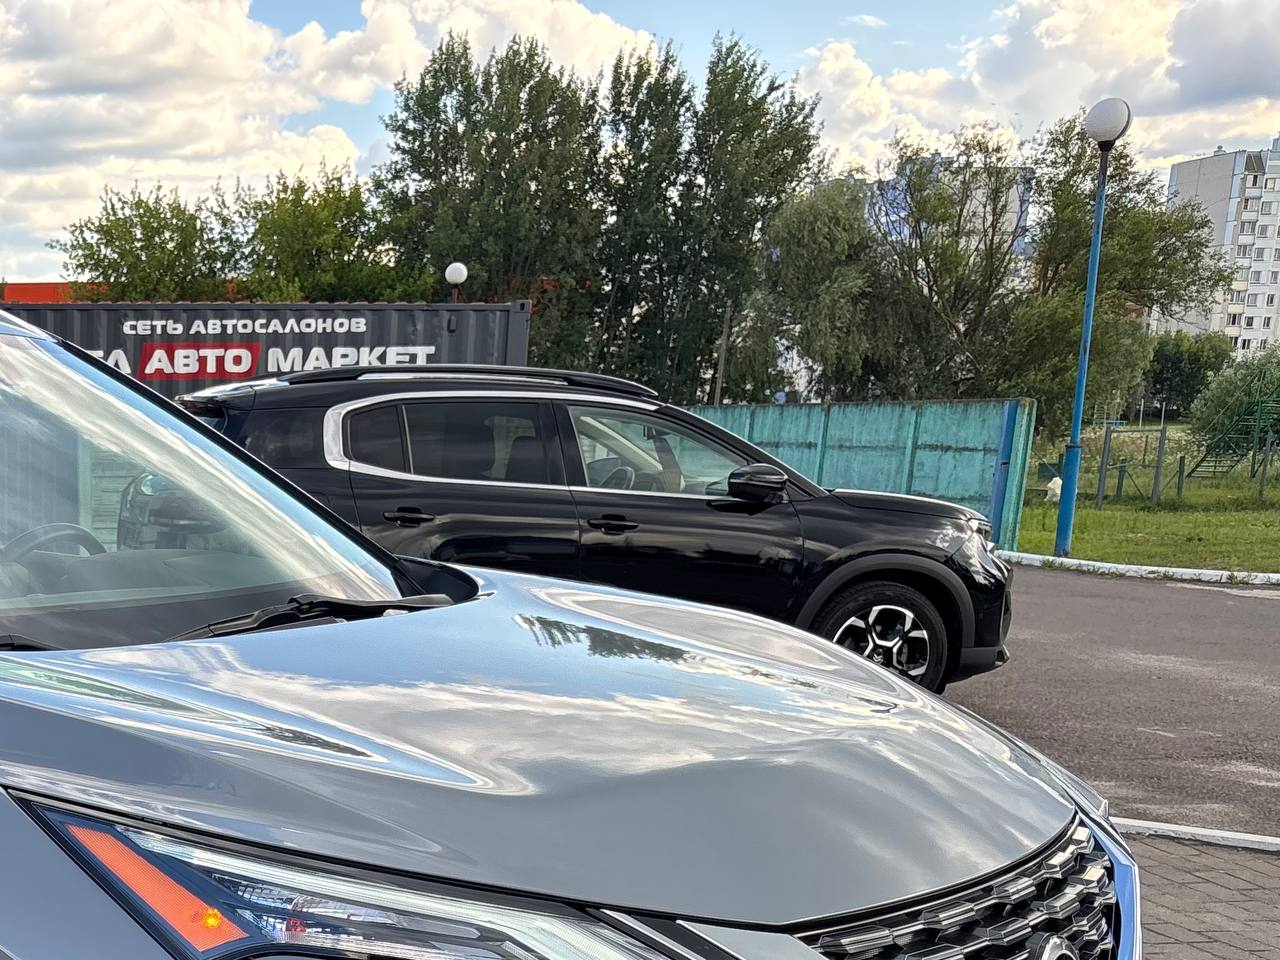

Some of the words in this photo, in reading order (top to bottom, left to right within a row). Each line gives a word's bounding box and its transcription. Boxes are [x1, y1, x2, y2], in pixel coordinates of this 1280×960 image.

[122, 320, 184, 335] СЕТЬ
[189, 318, 367, 335] АВТОСАЛОНОВ
[143, 348, 253, 374] АВТО
[267, 346, 436, 372] МАРКЕТ
